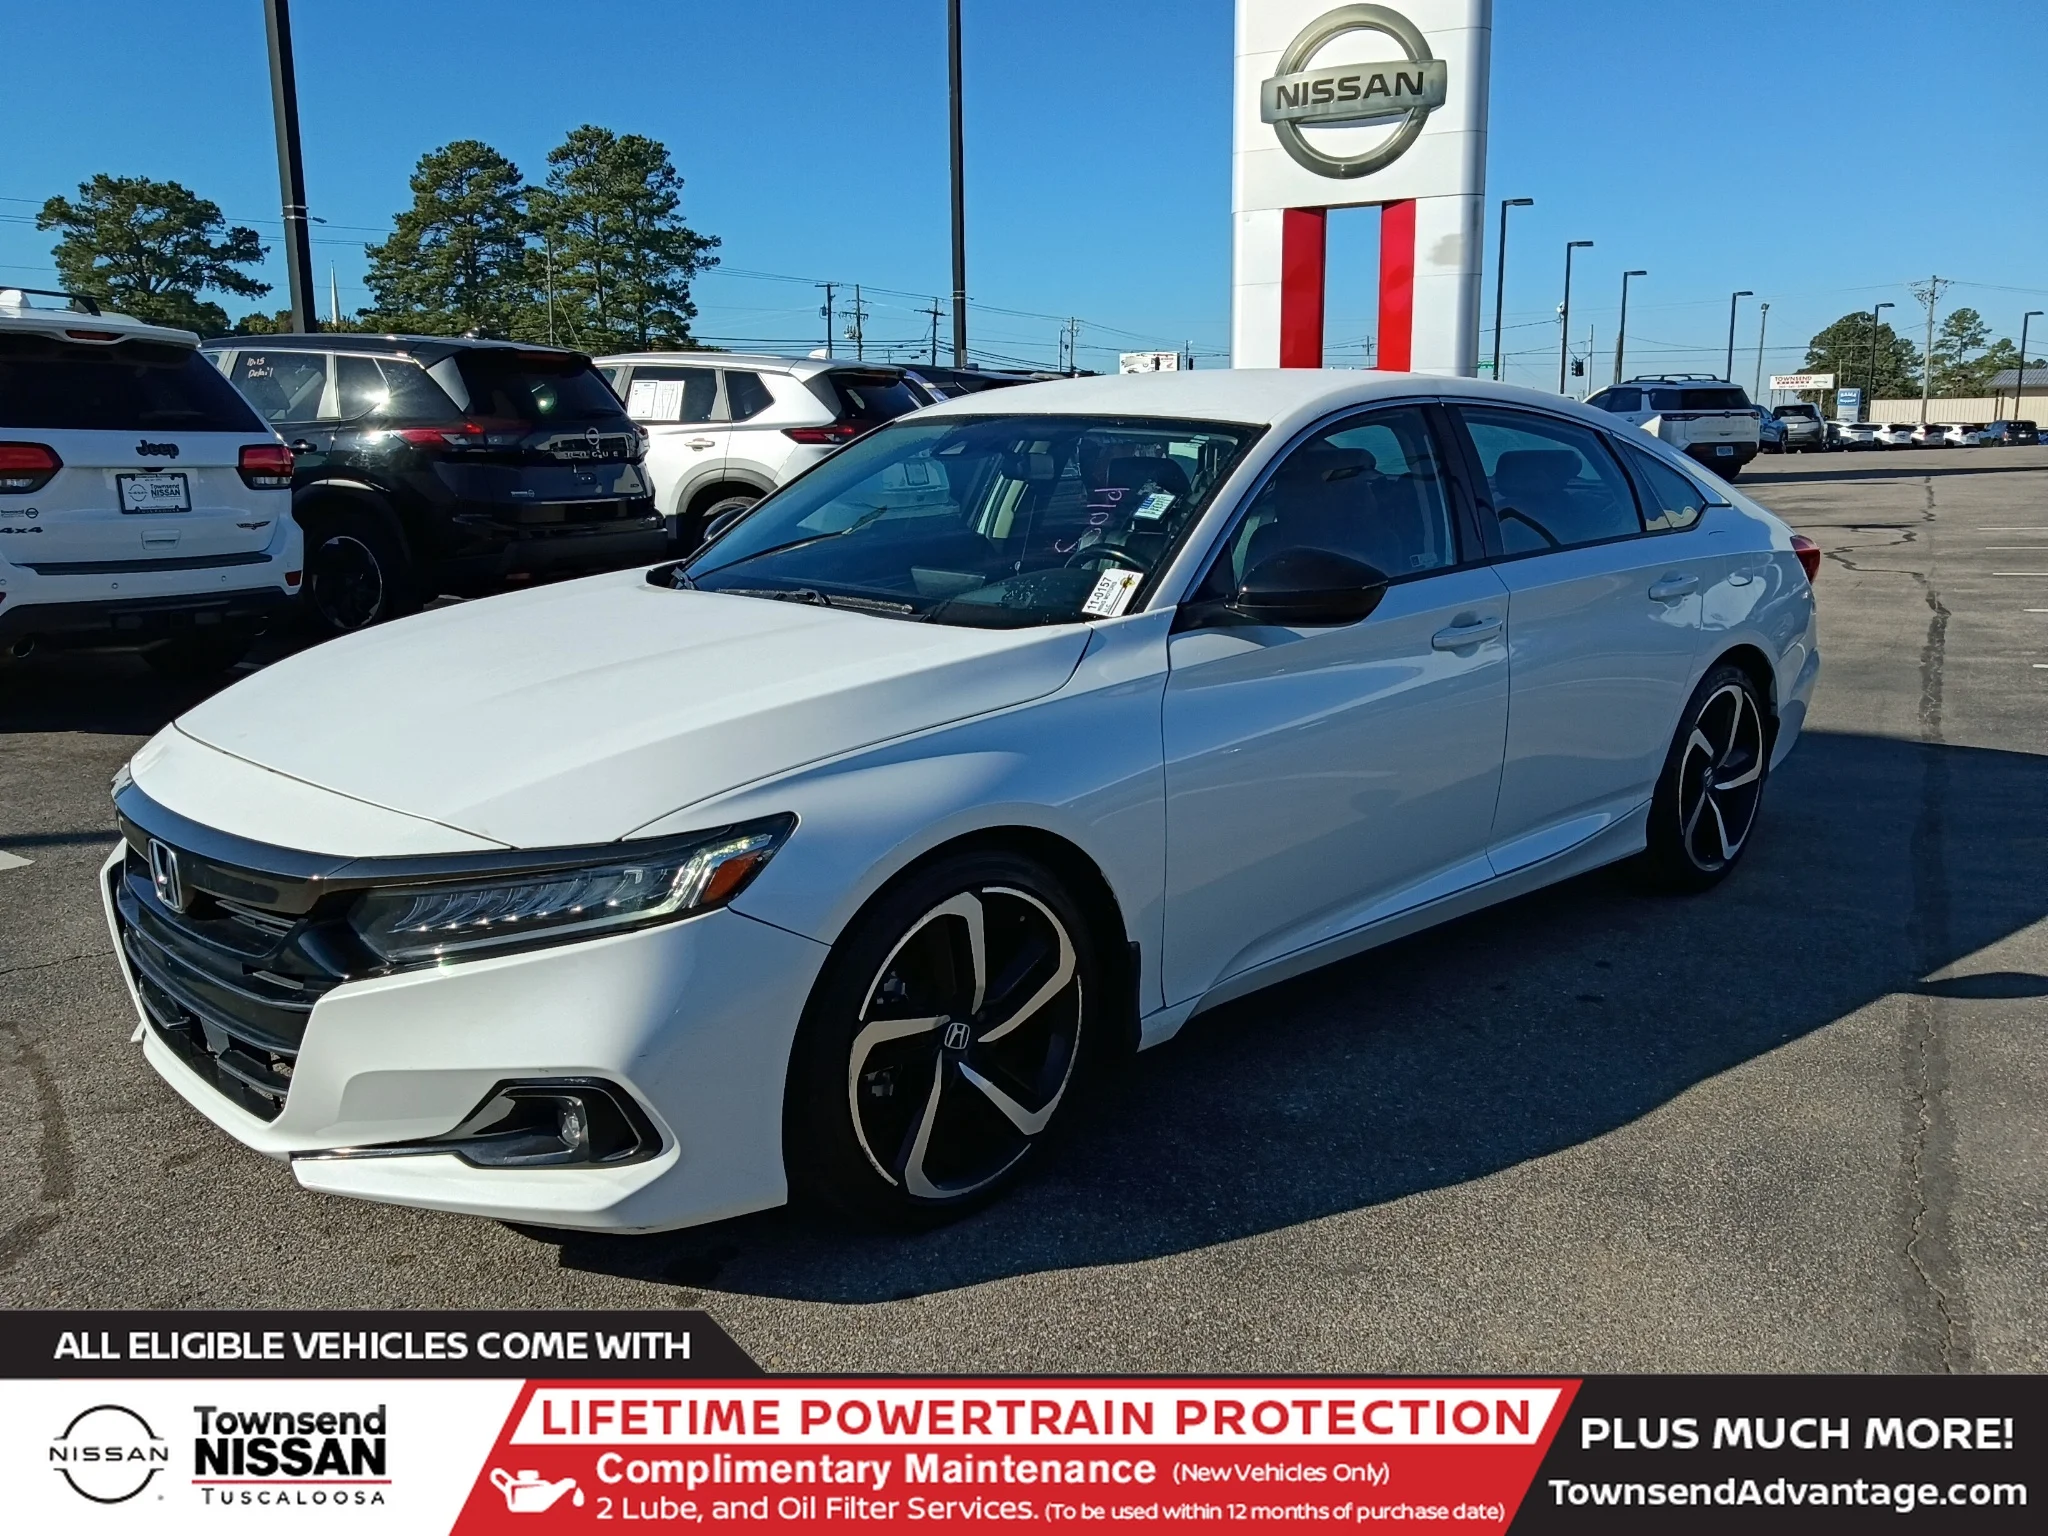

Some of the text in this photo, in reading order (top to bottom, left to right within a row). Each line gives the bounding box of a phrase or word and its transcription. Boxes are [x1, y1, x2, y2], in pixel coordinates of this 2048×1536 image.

[1276, 71, 1424, 110] NISSAN
[136, 440, 179, 459] Jeep
[1088, 577, 1111, 610] 11-0157
